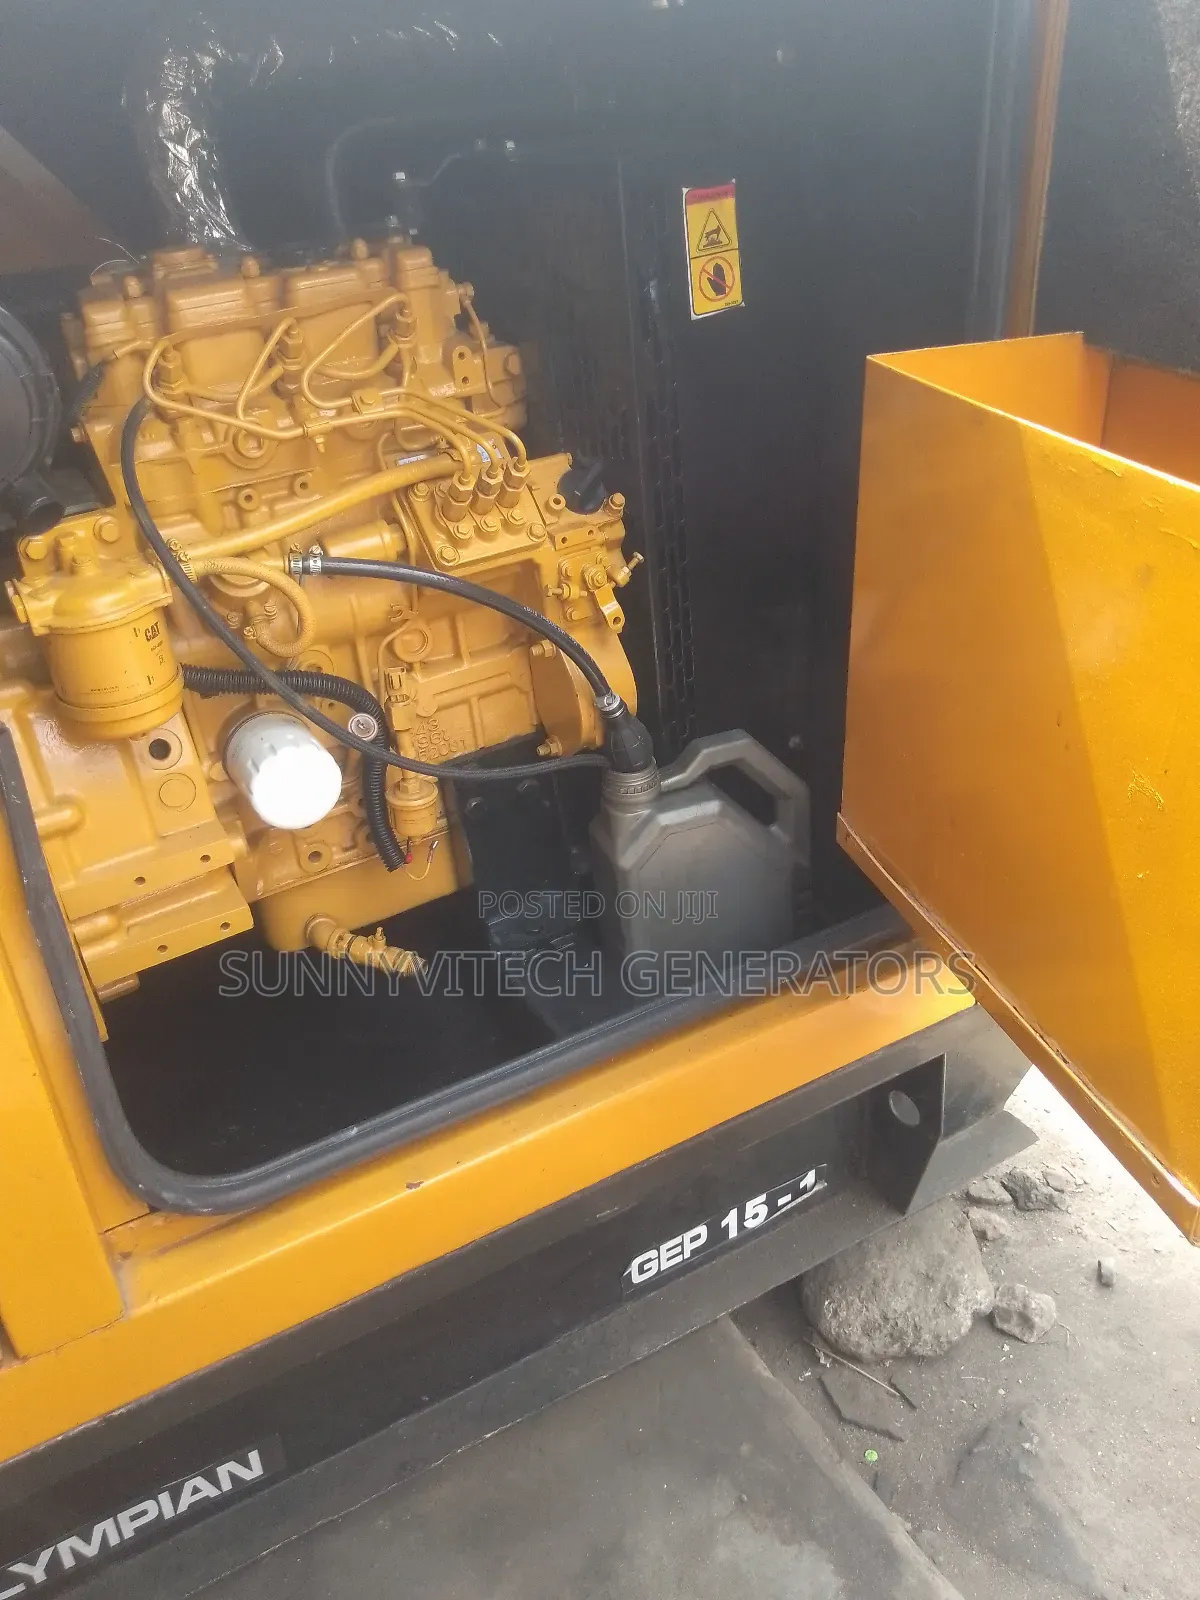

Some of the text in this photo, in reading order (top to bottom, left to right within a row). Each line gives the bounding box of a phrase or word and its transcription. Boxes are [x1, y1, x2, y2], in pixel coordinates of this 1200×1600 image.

[144, 621, 160, 642] CAT
[631, 1224, 708, 1284] GEP
[721, 1193, 769, 1240] 15
